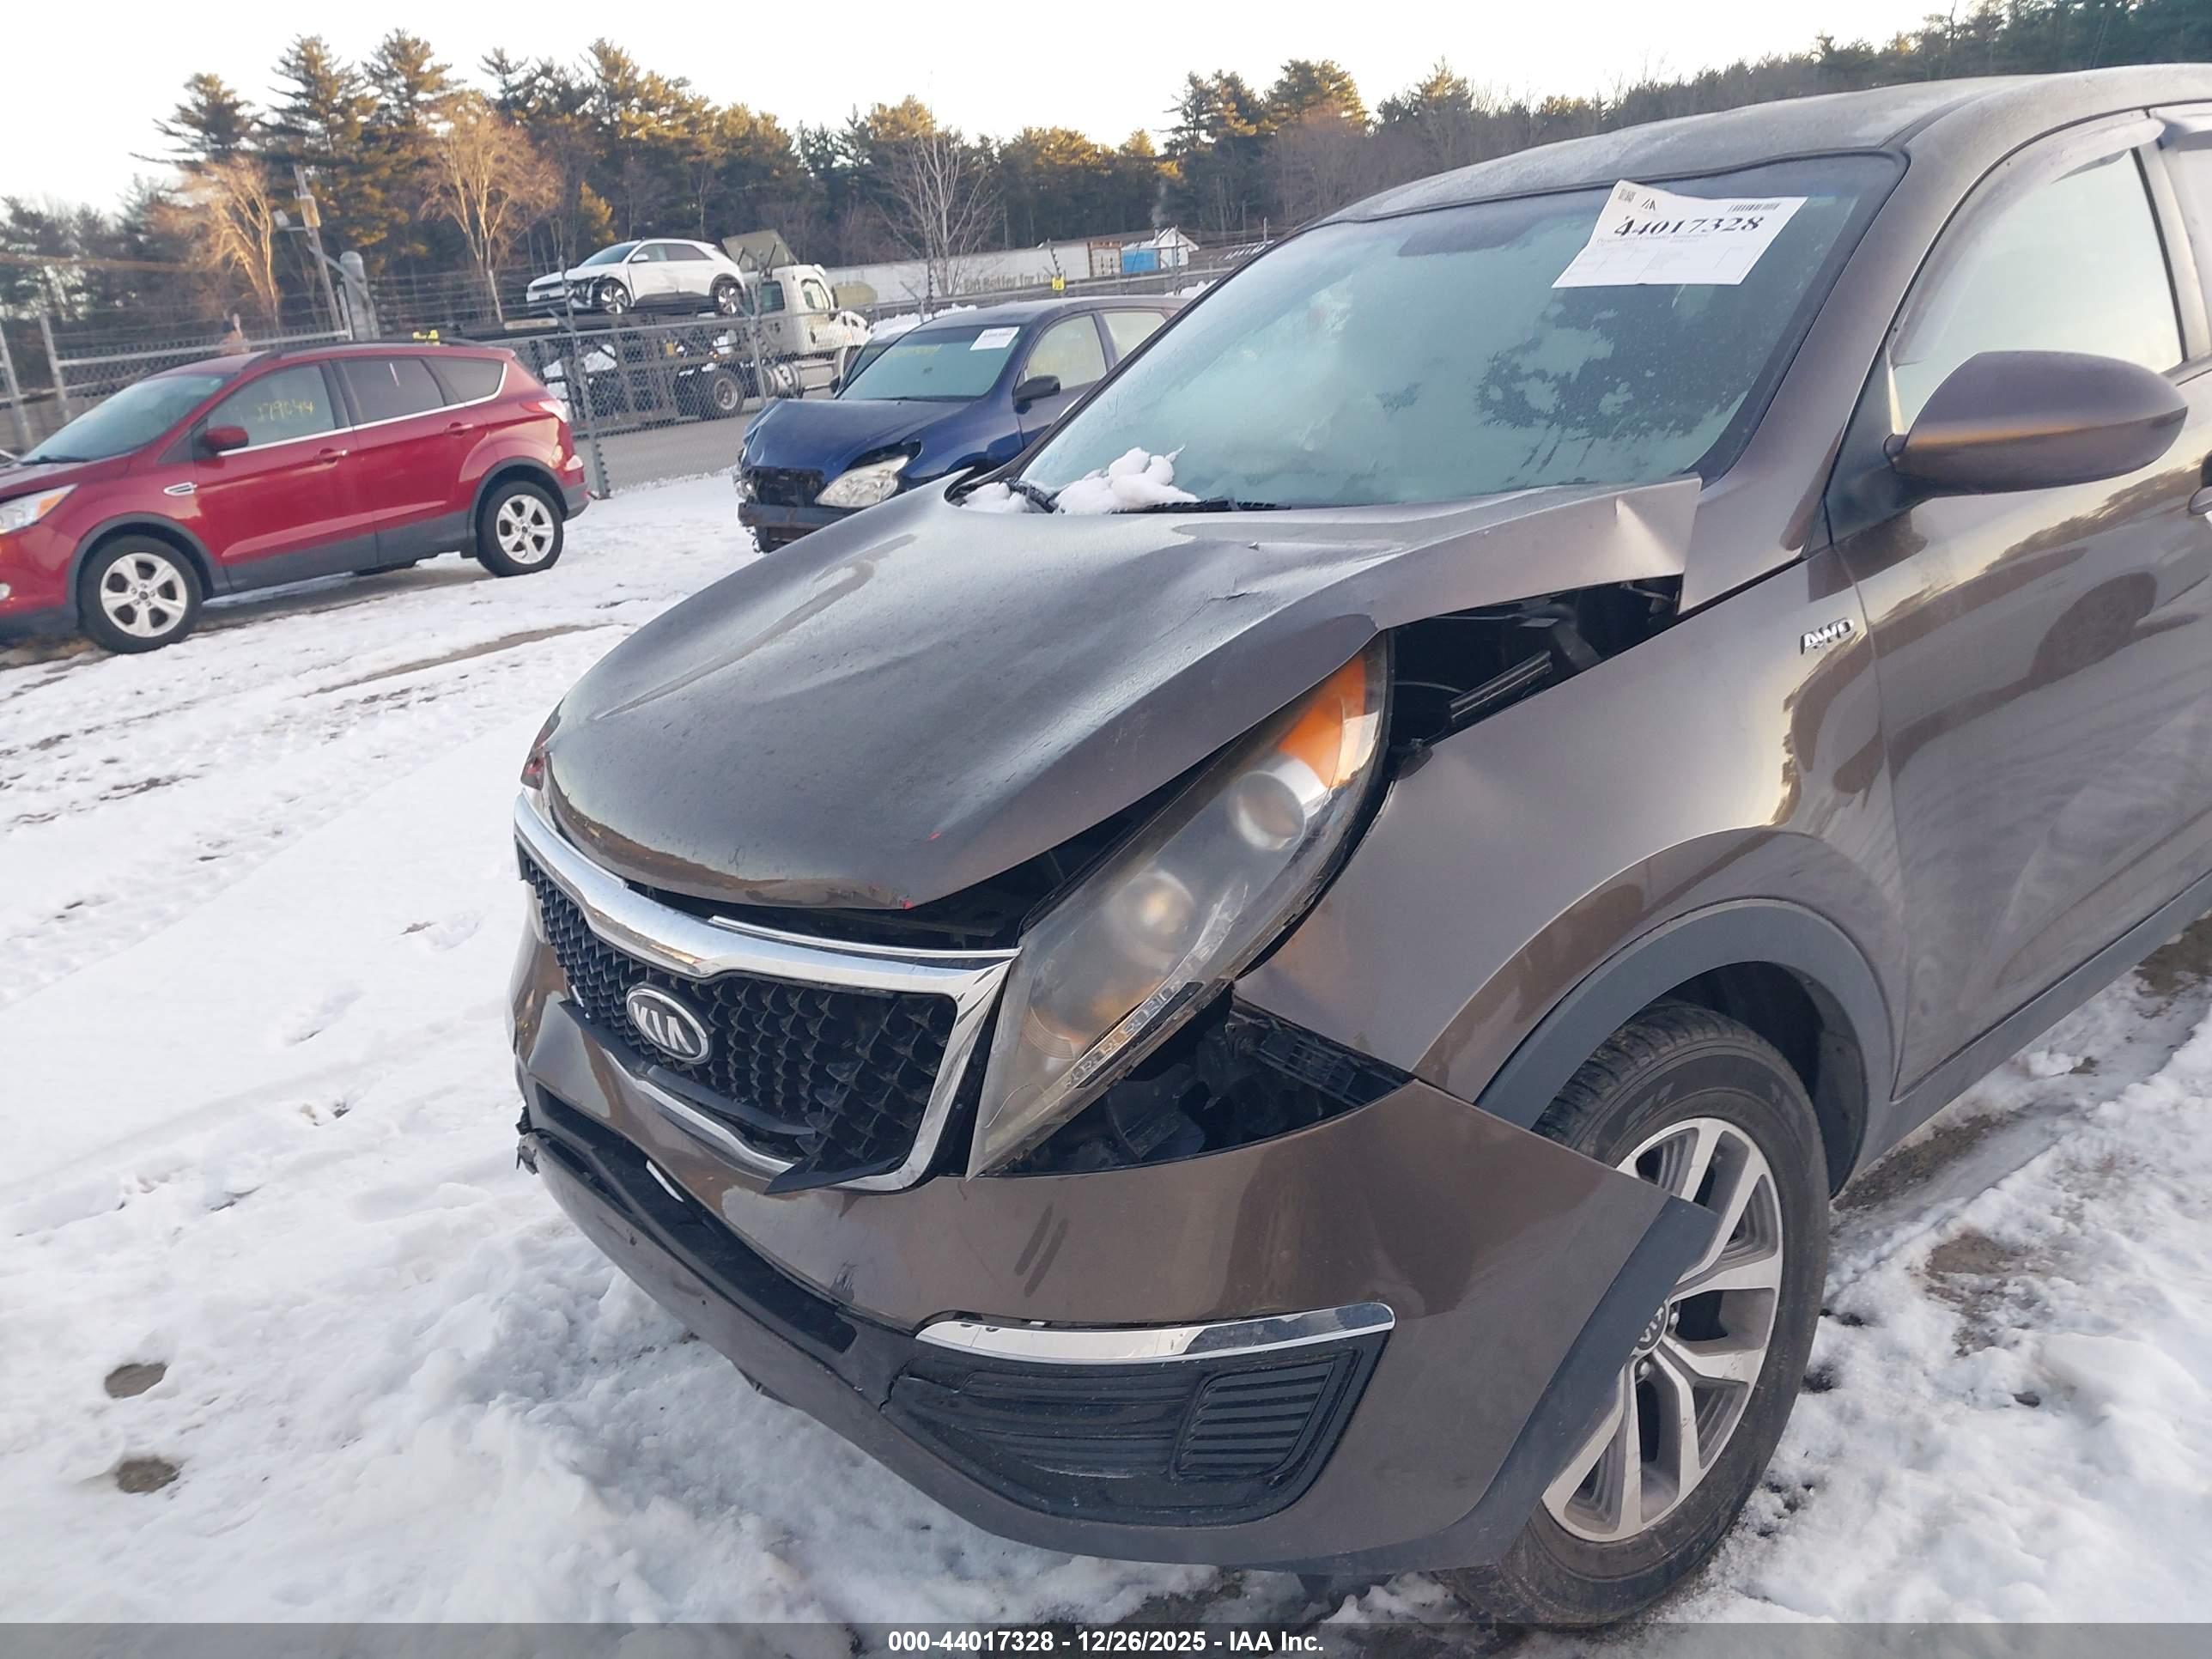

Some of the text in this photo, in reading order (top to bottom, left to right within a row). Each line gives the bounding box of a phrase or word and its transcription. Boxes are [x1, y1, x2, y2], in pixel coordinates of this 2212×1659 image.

[1613, 215, 1765, 237] 44017328
[1800, 617, 1856, 654] AWD
[631, 1001, 697, 1055] KIA
